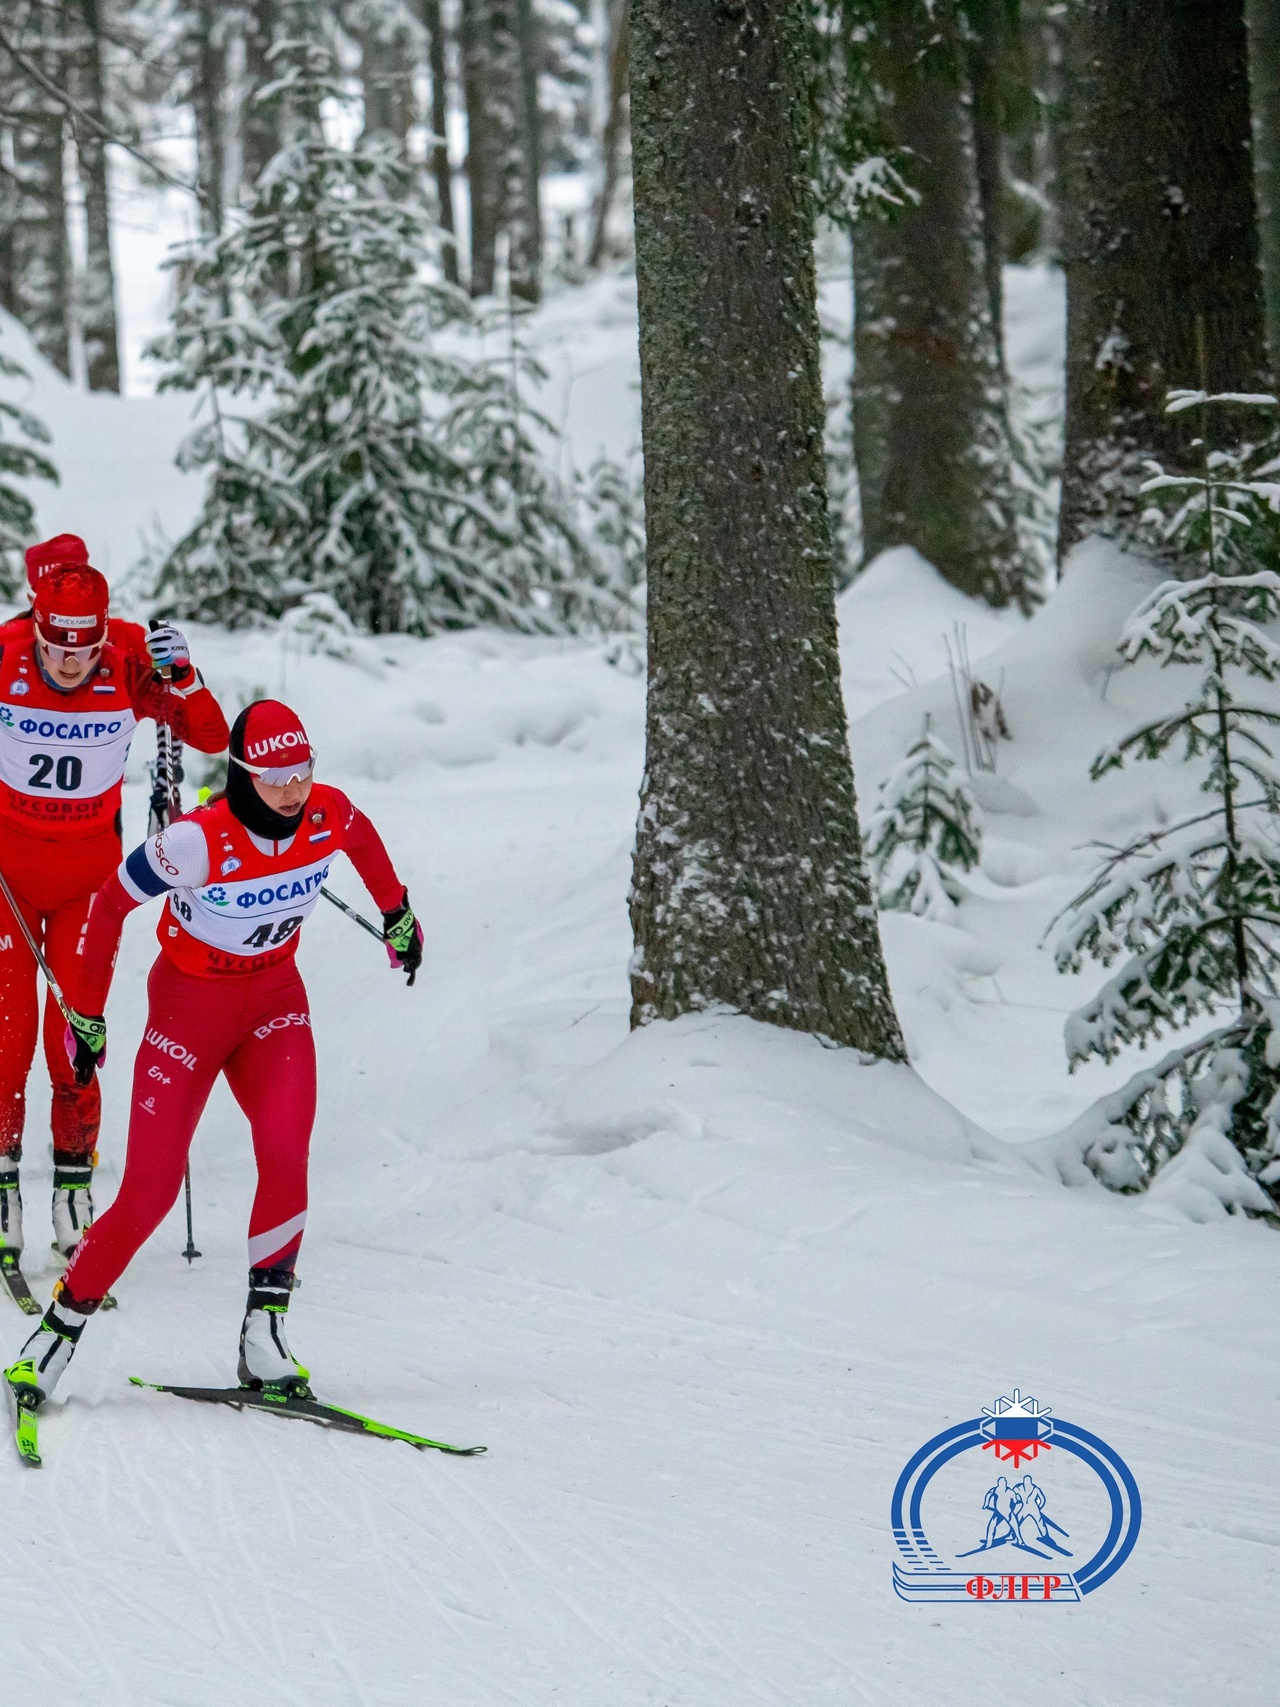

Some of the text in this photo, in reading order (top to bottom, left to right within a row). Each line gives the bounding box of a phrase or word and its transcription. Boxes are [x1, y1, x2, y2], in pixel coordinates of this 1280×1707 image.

[19, 719, 122, 739] ФОСАГРО
[247, 730, 308, 760] LUKOIL
[28, 753, 83, 791] 20
[236, 864, 330, 909] ФОСАГРО
[242, 915, 304, 948] 48
[253, 1012, 312, 1040] BOSC
[145, 1027, 198, 1071] LUKOIL
